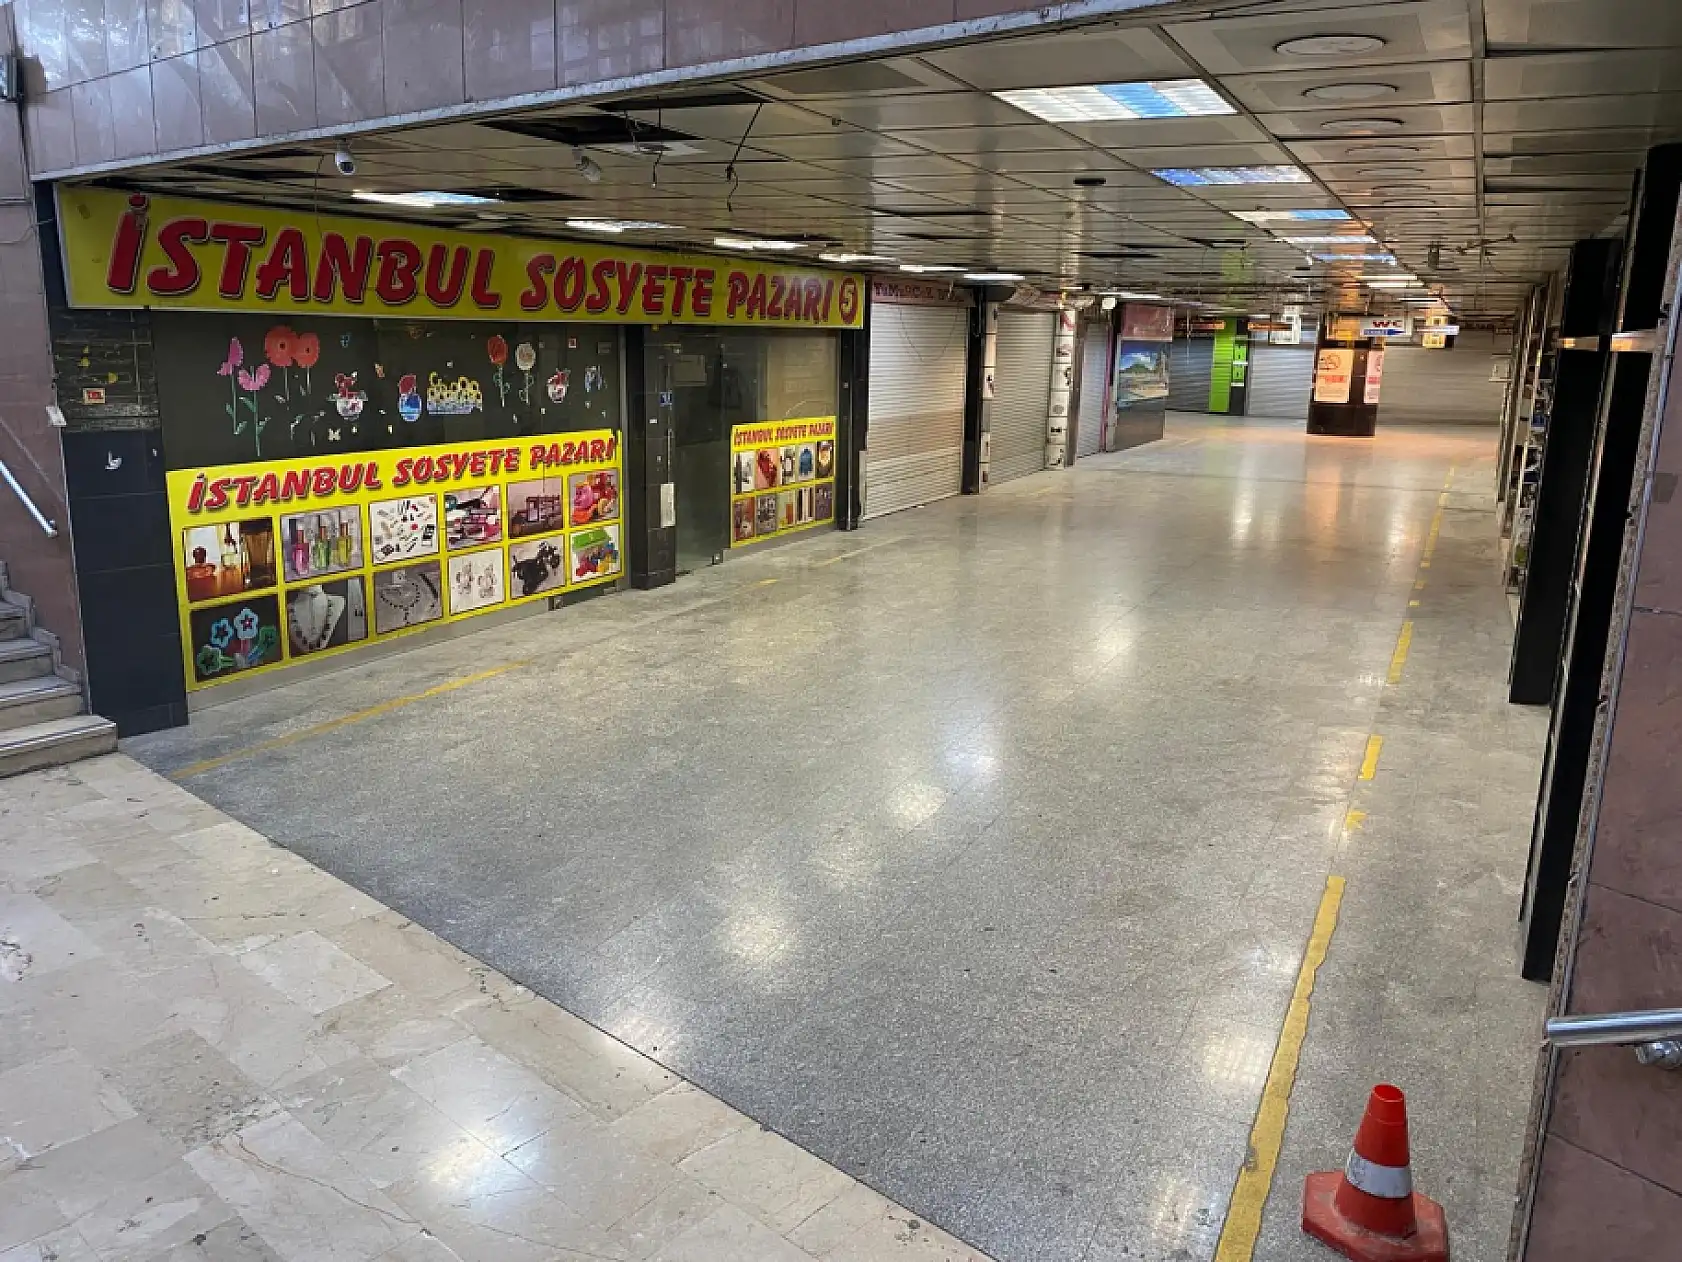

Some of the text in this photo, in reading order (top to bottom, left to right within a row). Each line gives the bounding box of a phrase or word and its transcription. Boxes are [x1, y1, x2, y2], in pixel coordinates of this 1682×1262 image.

[107, 192, 502, 307] İSTANBUL
[520, 253, 715, 317] SOSYETE
[726, 271, 835, 324] PAZARI
[187, 437, 616, 513] İSTANBUL SOSYETE PAZARI
